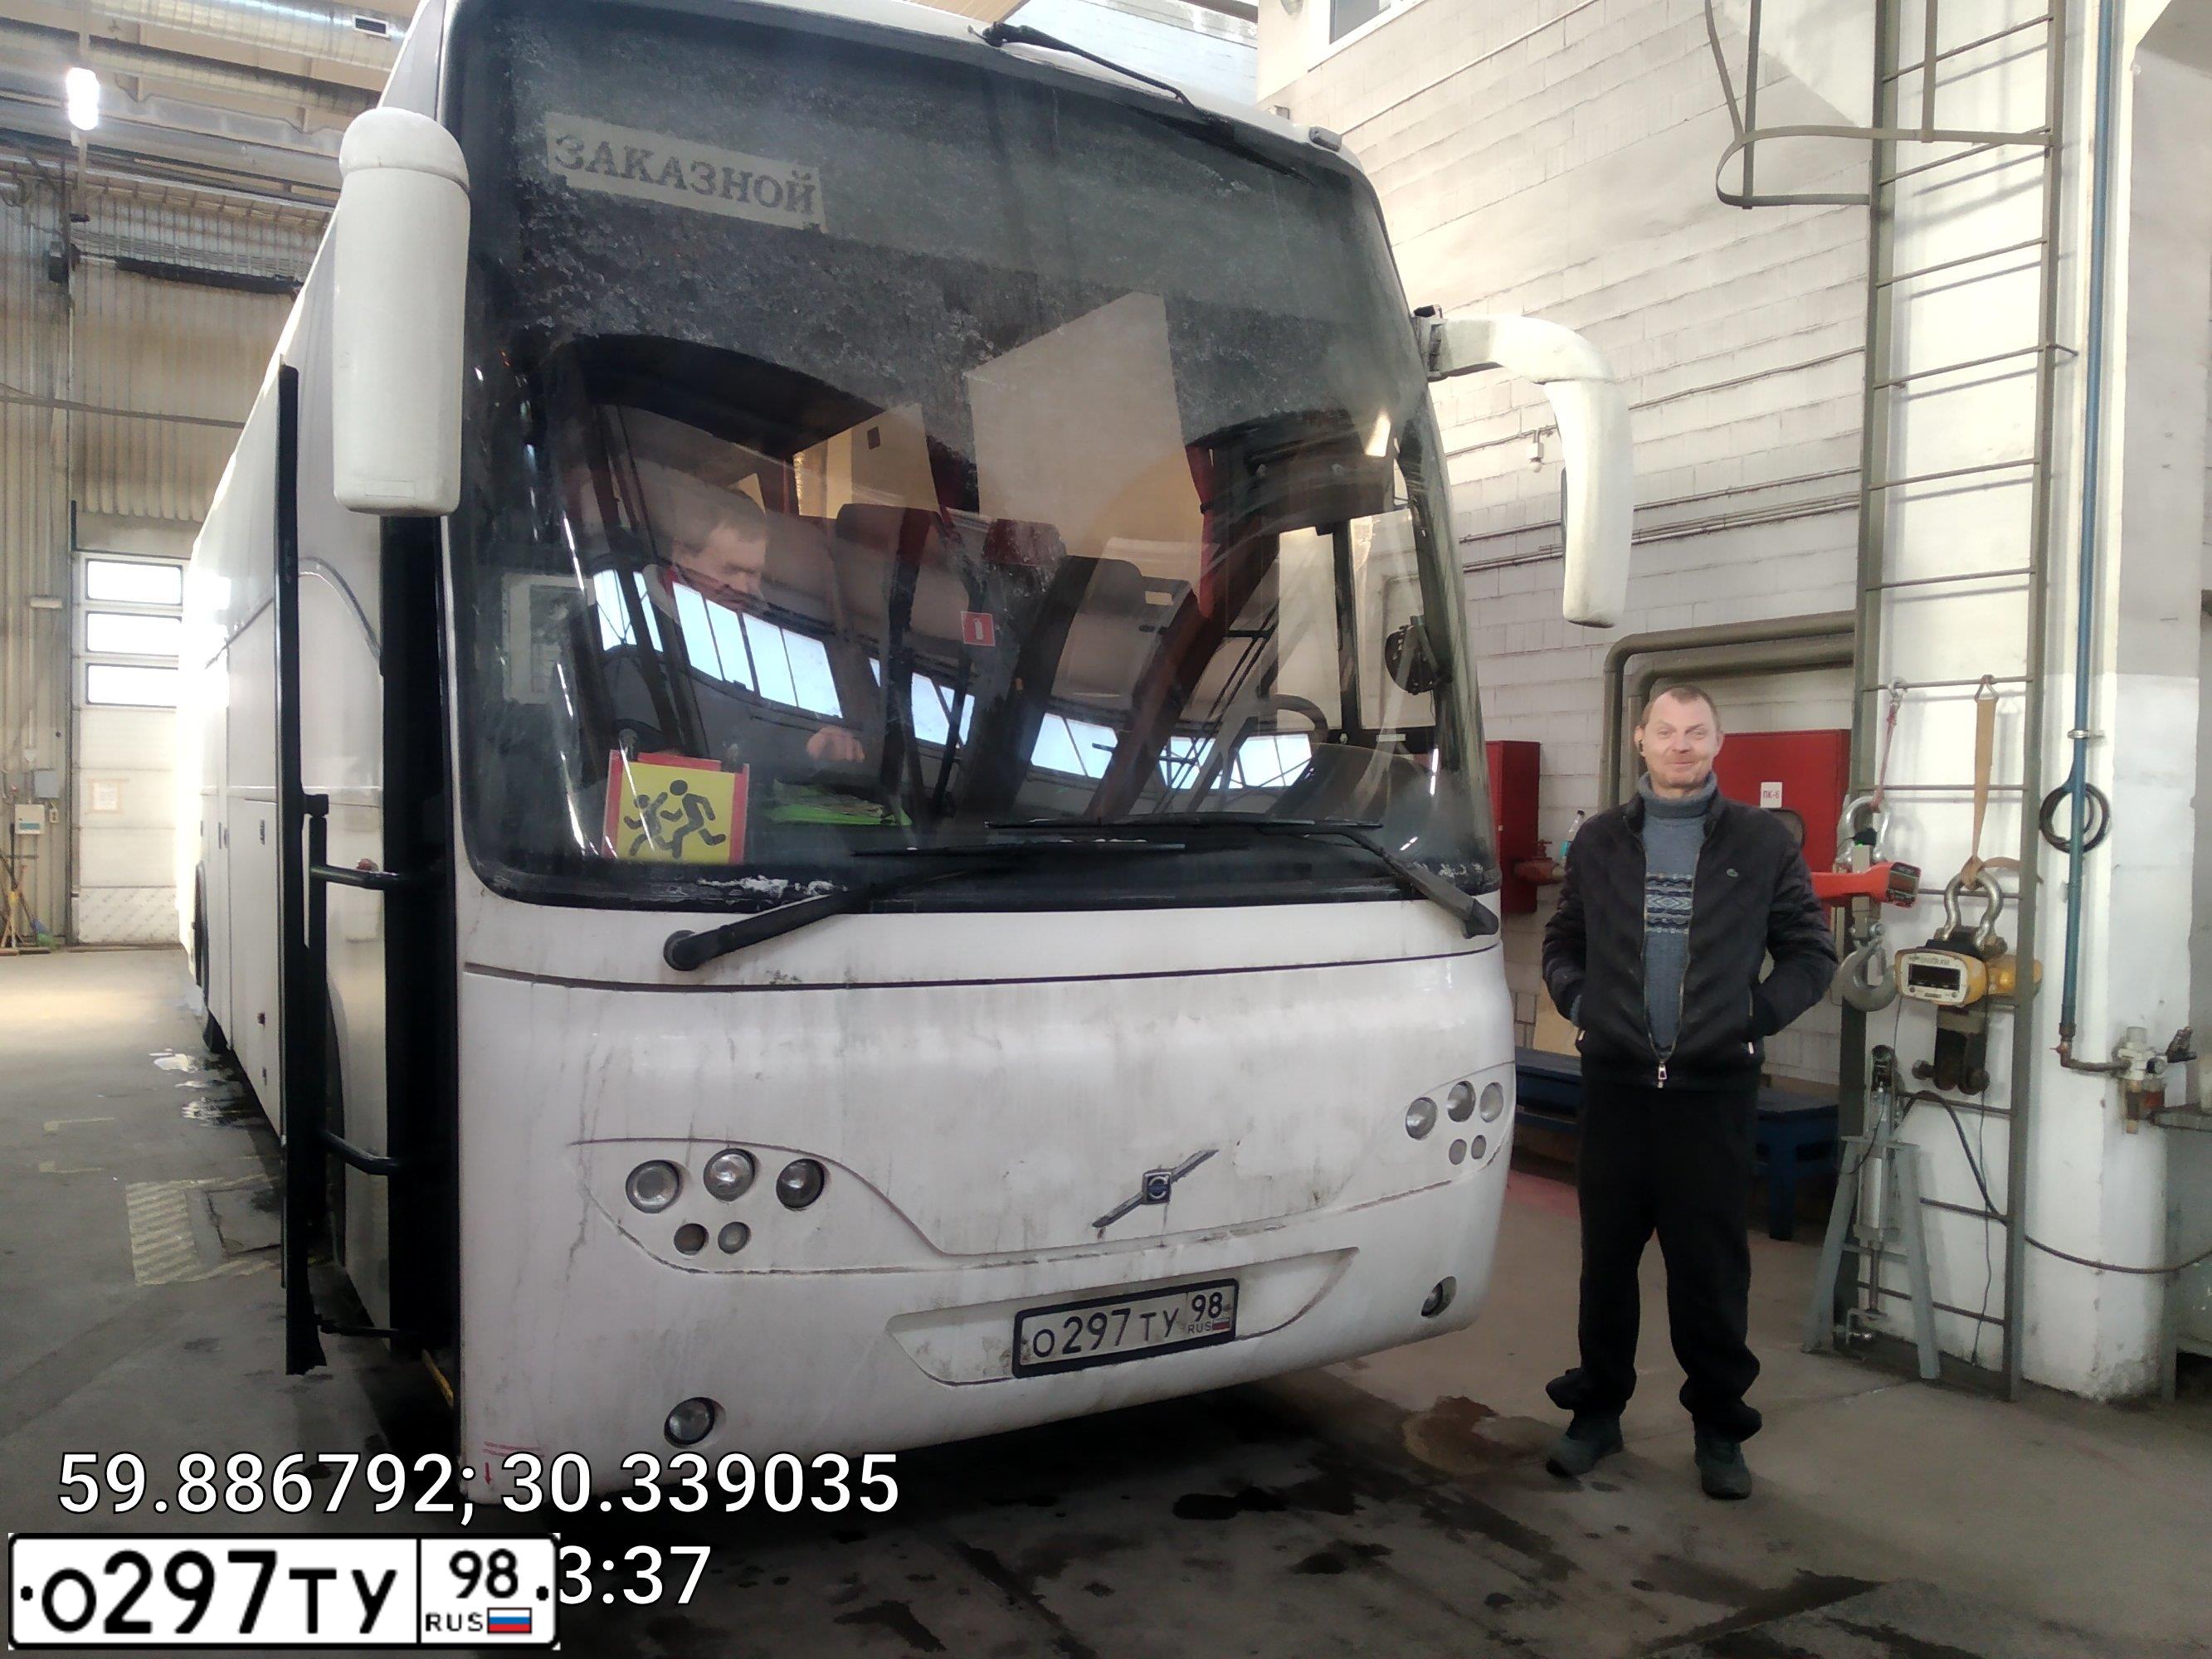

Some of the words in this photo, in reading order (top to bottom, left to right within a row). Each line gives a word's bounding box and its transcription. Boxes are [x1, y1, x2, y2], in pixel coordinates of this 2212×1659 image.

[554, 134, 816, 215] ЗАКАЗНОЙ
[1191, 1292, 1223, 1322] 98
[1187, 1321, 1212, 1335] RUS
